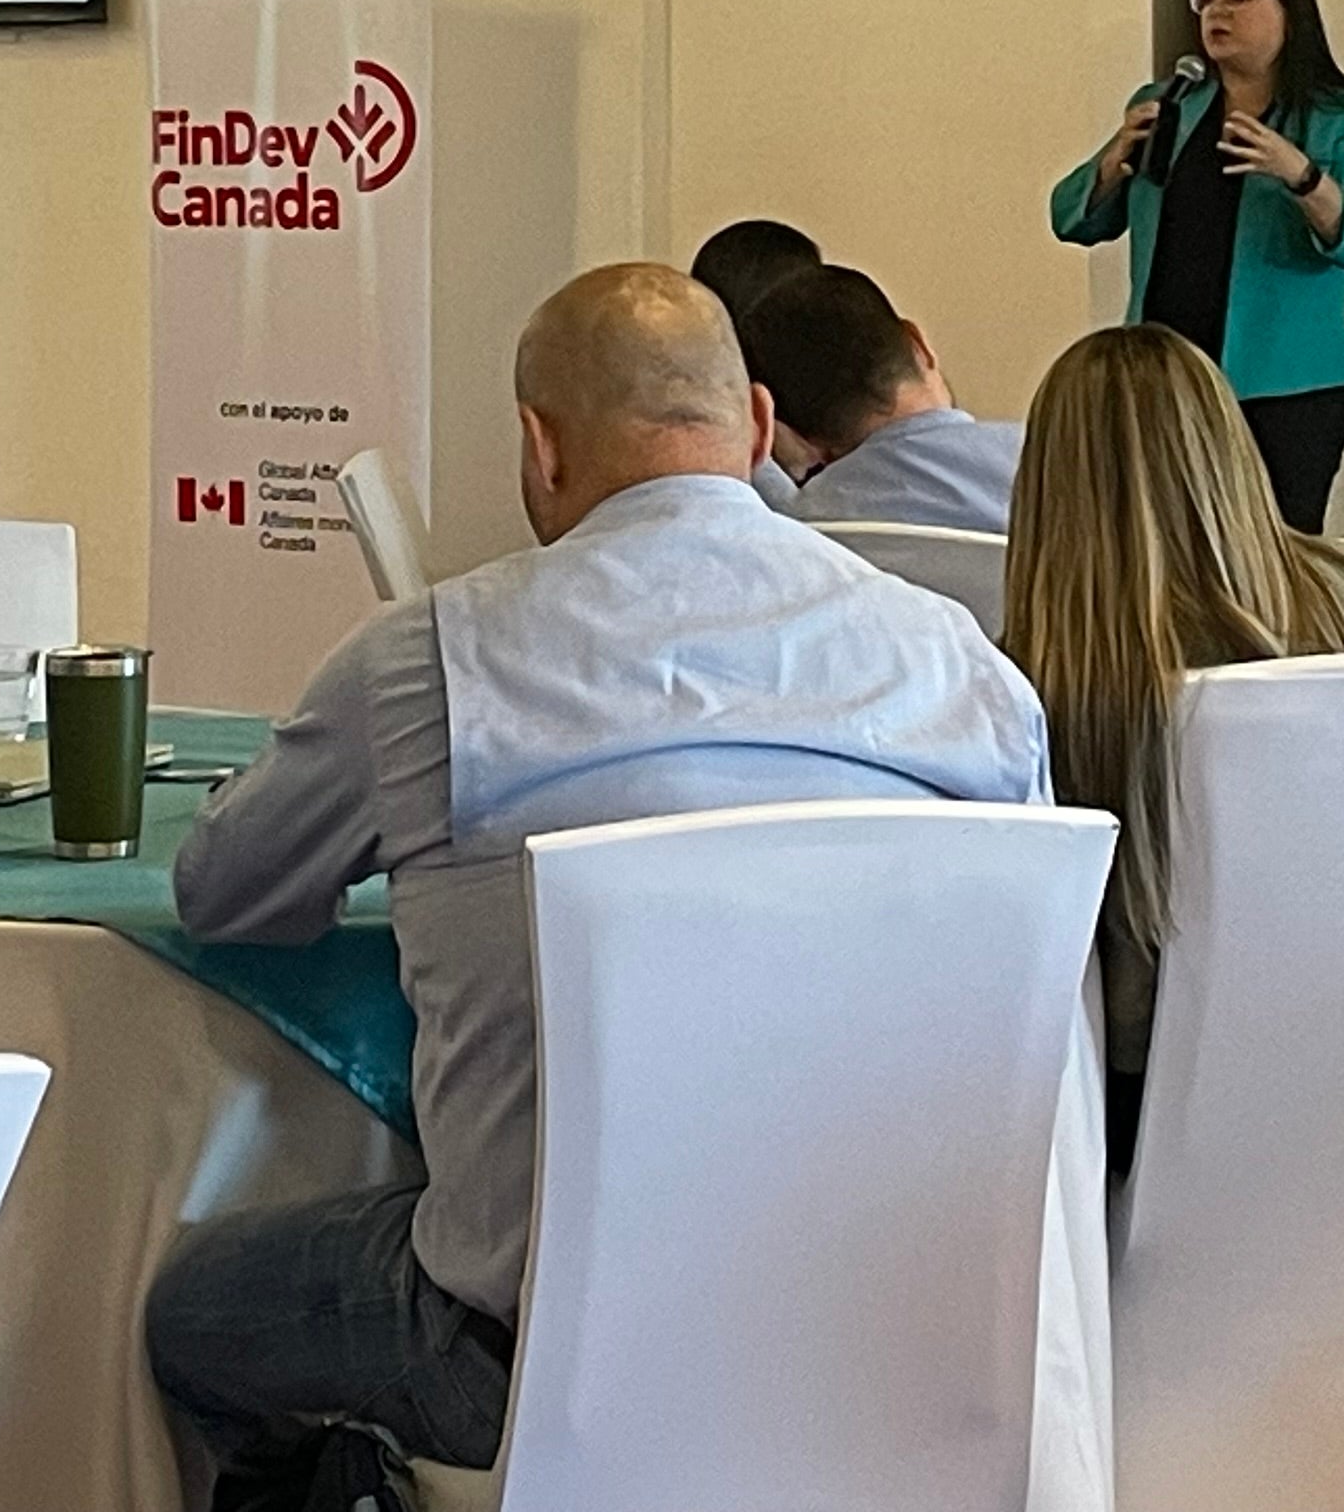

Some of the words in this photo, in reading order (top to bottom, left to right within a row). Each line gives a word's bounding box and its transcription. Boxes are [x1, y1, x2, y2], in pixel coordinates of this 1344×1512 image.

[151, 109, 319, 168] FinDev
[151, 170, 340, 231] Canada
[220, 402, 249, 418] con
[252, 401, 266, 418] el
[271, 405, 324, 424] apoyo
[328, 405, 349, 422] de
